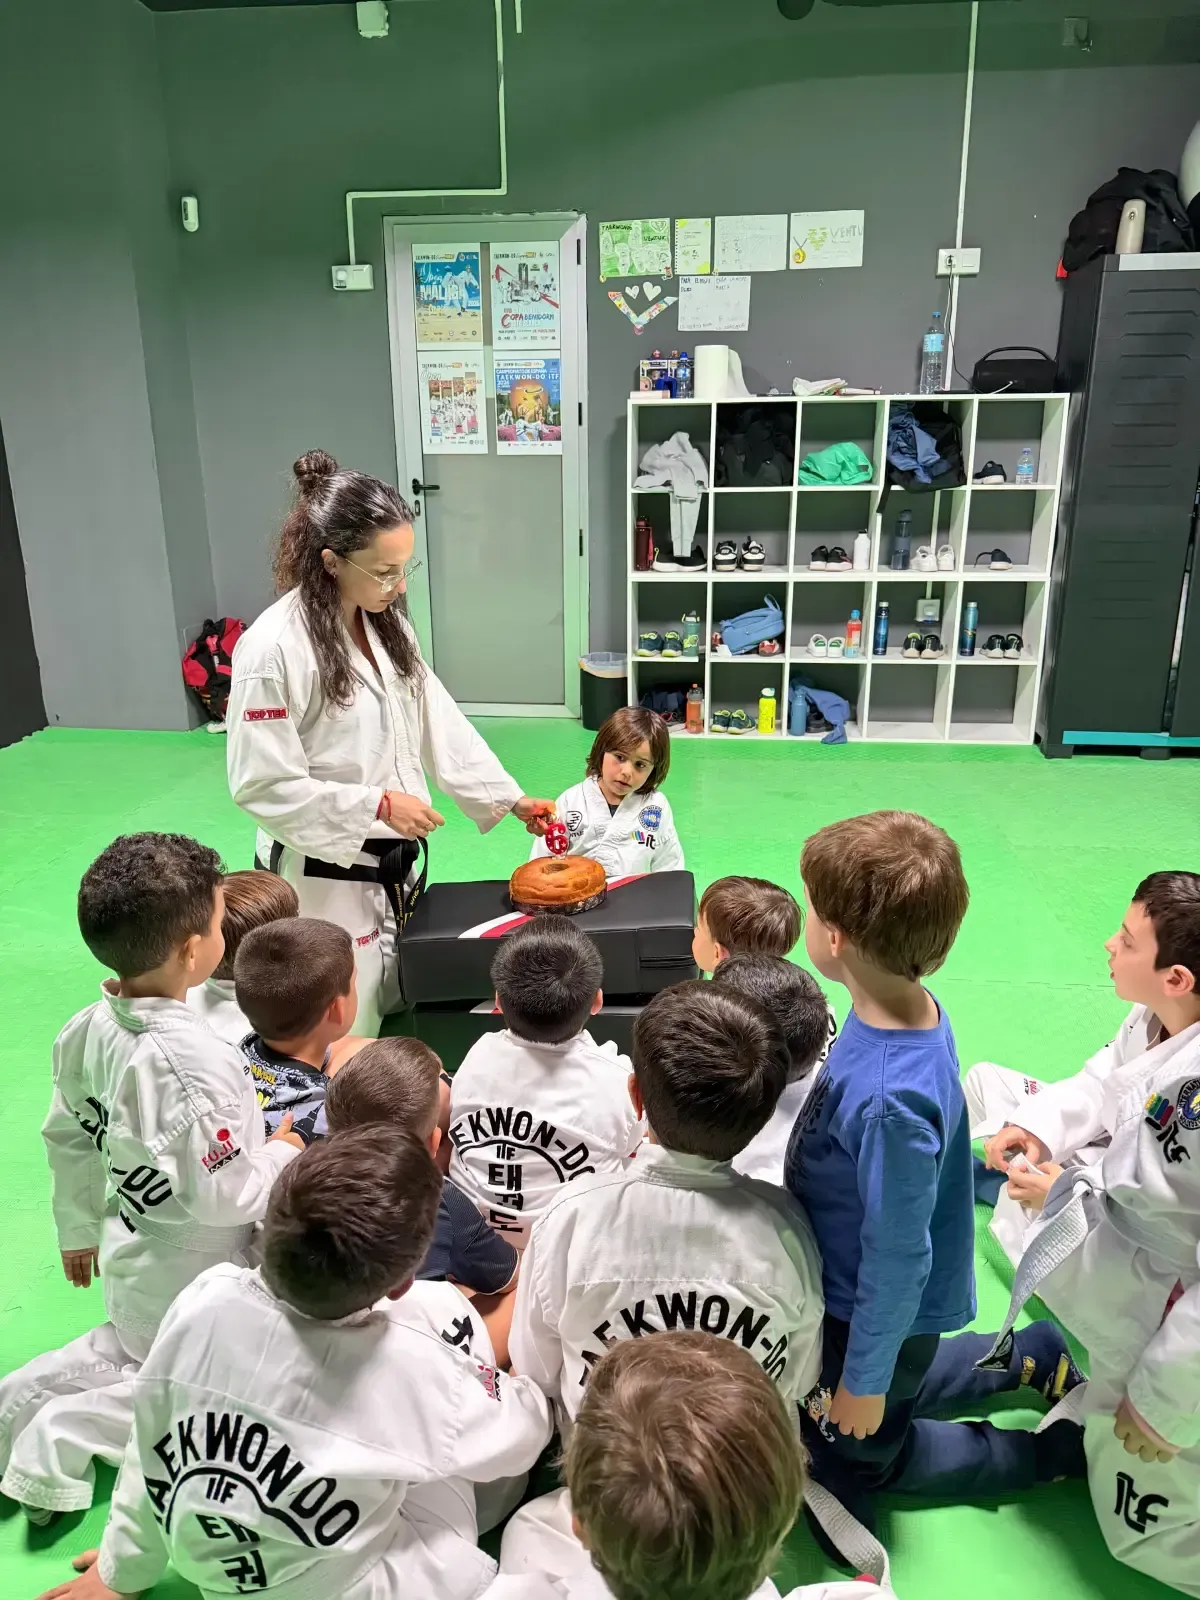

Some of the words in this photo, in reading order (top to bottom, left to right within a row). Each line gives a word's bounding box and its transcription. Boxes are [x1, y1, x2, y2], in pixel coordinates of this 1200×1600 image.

[247, 710, 266, 720] TOP
[545, 822, 569, 855] 6
[496, 1144, 516, 1160] ITF
[205, 1475, 238, 1504] ITF
